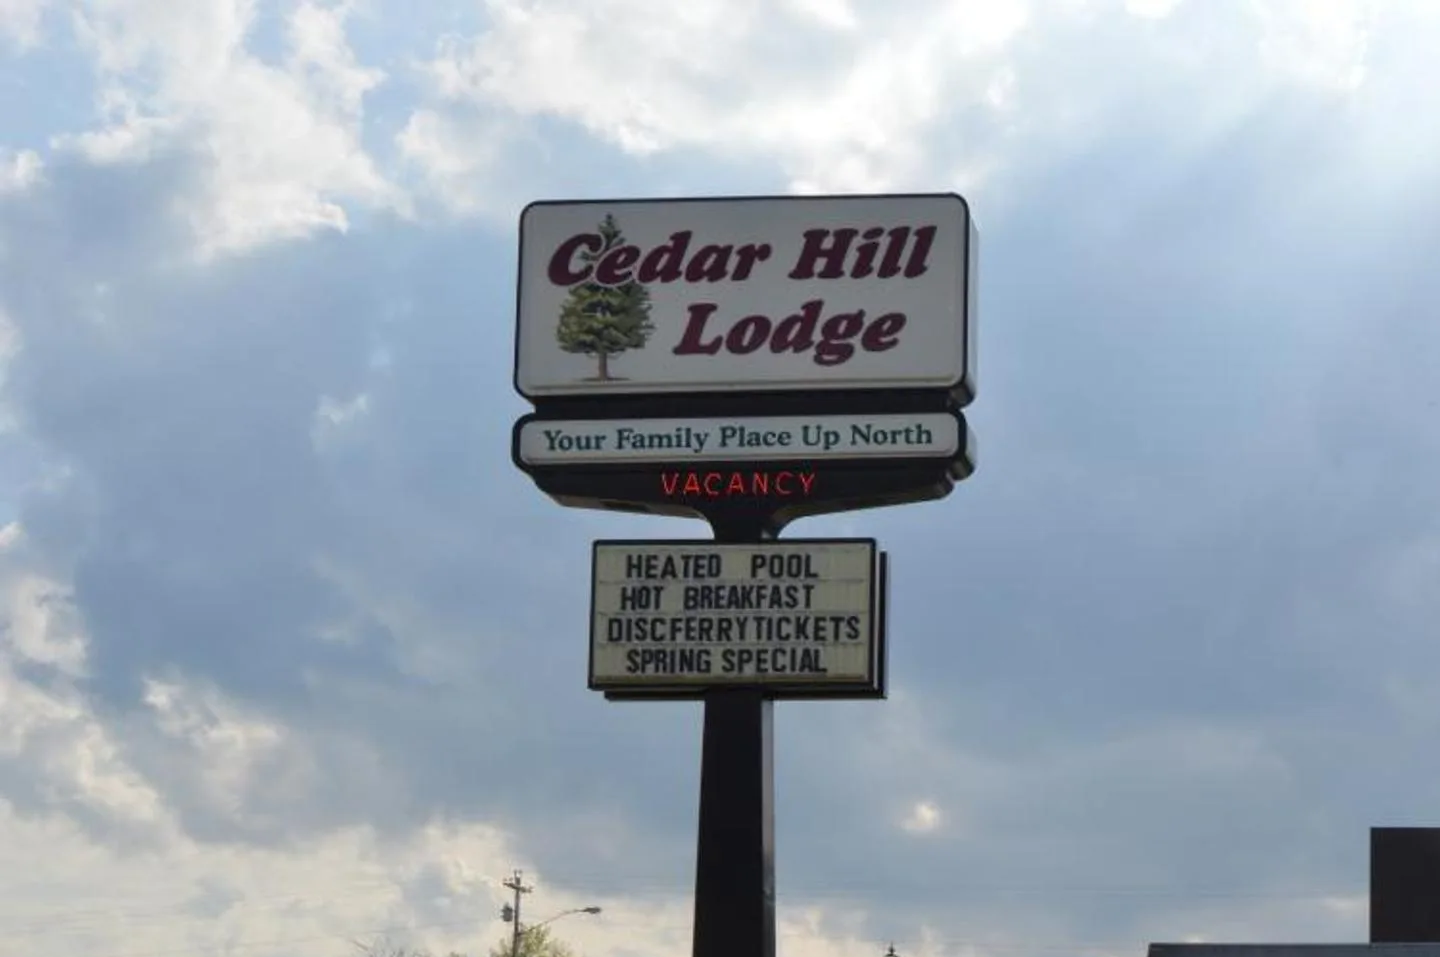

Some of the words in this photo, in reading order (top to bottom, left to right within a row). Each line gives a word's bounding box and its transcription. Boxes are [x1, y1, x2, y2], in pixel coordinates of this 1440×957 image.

[548, 230, 772, 287] Cedar
[788, 225, 937, 280] Hill
[673, 299, 907, 366] Lodge
[543, 429, 606, 452] Your
[615, 426, 711, 453] Family
[718, 425, 791, 448] Place
[802, 425, 841, 447] Up
[850, 423, 933, 445] North
[661, 471, 816, 496] VACANCY
[626, 553, 722, 579] HEATED
[750, 553, 818, 579] POOL
[620, 585, 664, 611] HOT
[684, 584, 815, 610] BREAKFAST
[626, 648, 712, 674] SPRING
[721, 647, 828, 674] SPECIAL
